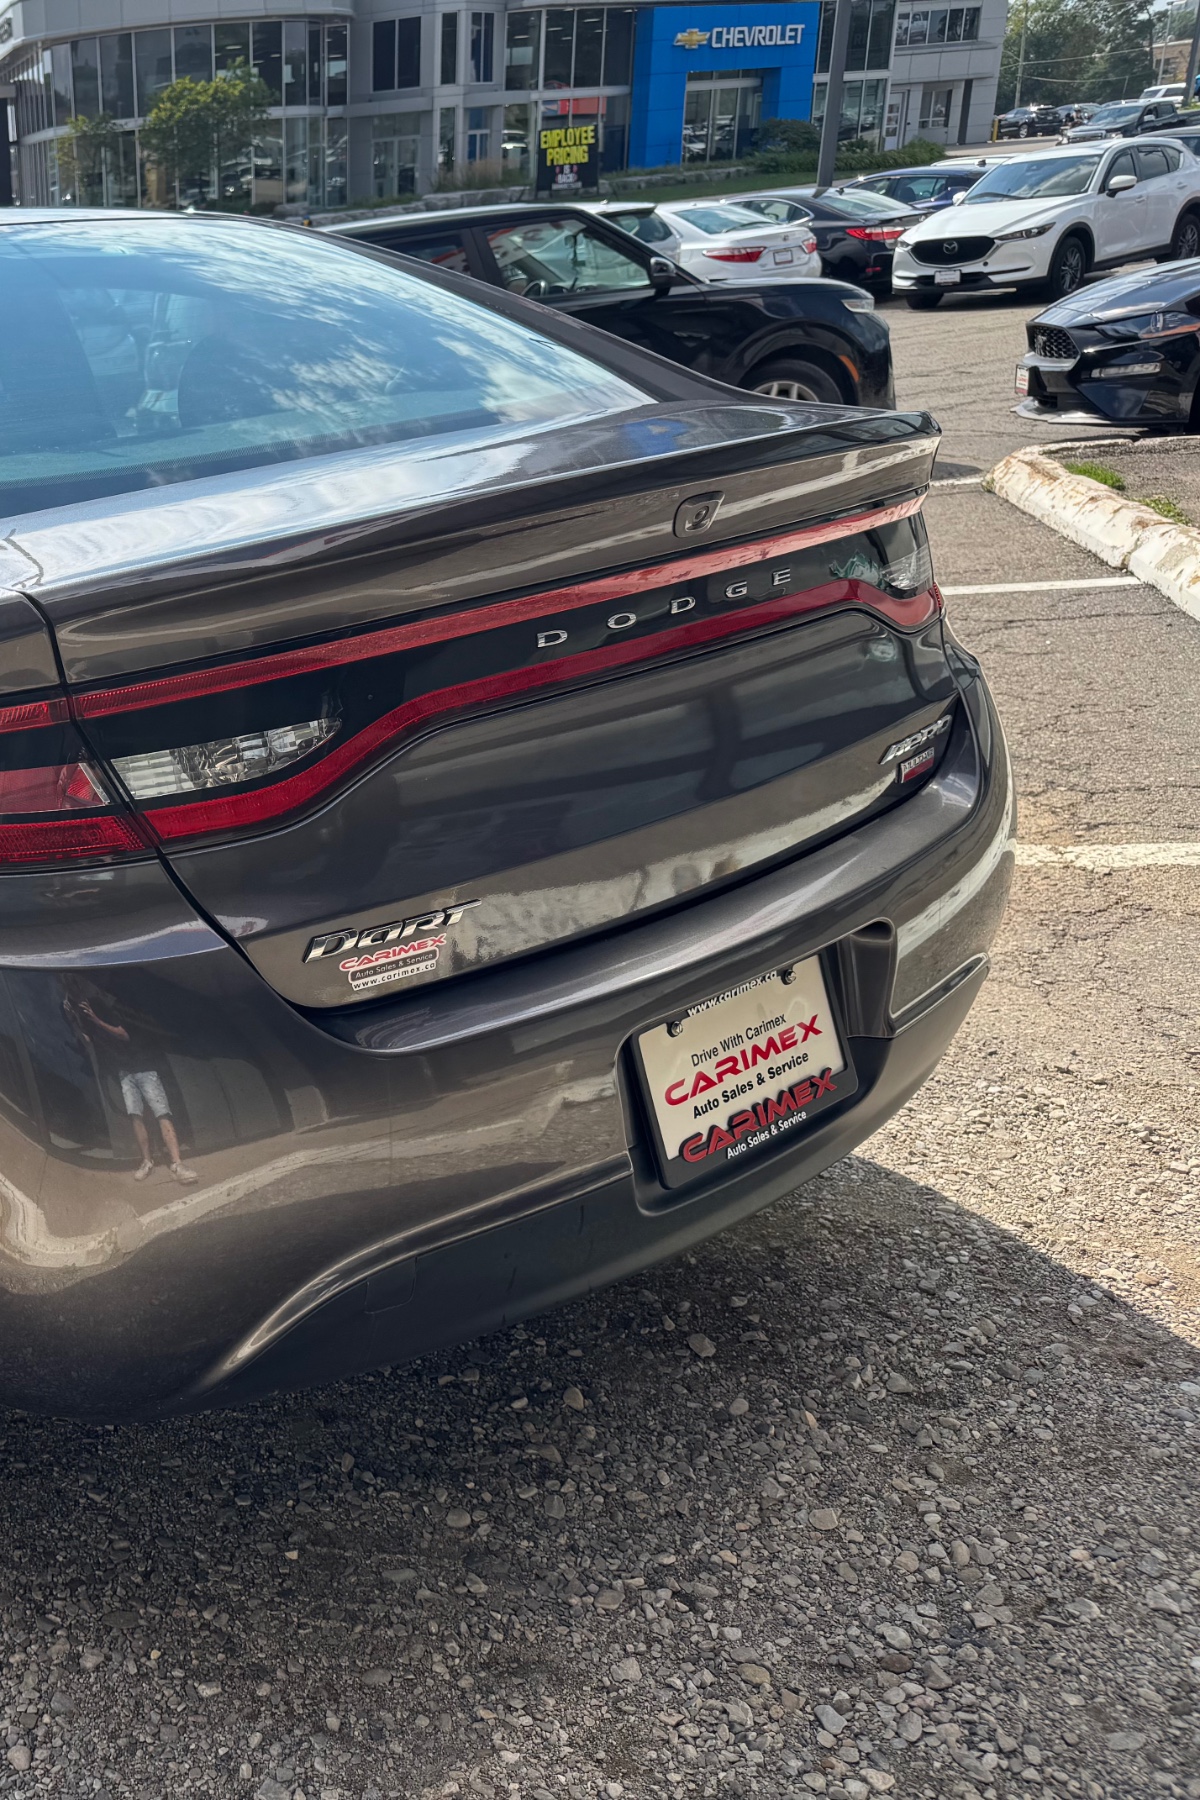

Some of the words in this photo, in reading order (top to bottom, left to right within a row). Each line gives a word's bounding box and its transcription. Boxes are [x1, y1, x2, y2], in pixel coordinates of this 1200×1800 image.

[711, 24, 806, 48] CHEVROLET
[540, 125, 596, 149] EMPLOYEE
[546, 145, 589, 167] PRICING
[537, 568, 792, 648] DODGE
[340, 934, 446, 970] CARIMEX
[353, 962, 436, 990] www.carimex.ca
[355, 969, 374, 979] Auto
[375, 963, 397, 974] Sales
[398, 960, 405, 968] &
[406, 953, 433, 965] Service
[687, 970, 778, 1018] www.carimex.ca
[664, 1013, 824, 1106] CARIMEX
[691, 1047, 719, 1067] Drive
[719, 1033, 744, 1052] With
[745, 1013, 787, 1040] Carimex
[693, 1097, 720, 1119] Auto
[721, 1080, 754, 1103] Sales
[756, 1072, 766, 1086] &
[767, 1052, 809, 1080] Service
[681, 1067, 838, 1163] CARIMEX
[726, 1139, 747, 1160] Auto
[747, 1129, 770, 1148] Sales
[770, 1124, 778, 1136] &
[779, 1110, 807, 1132] Service
